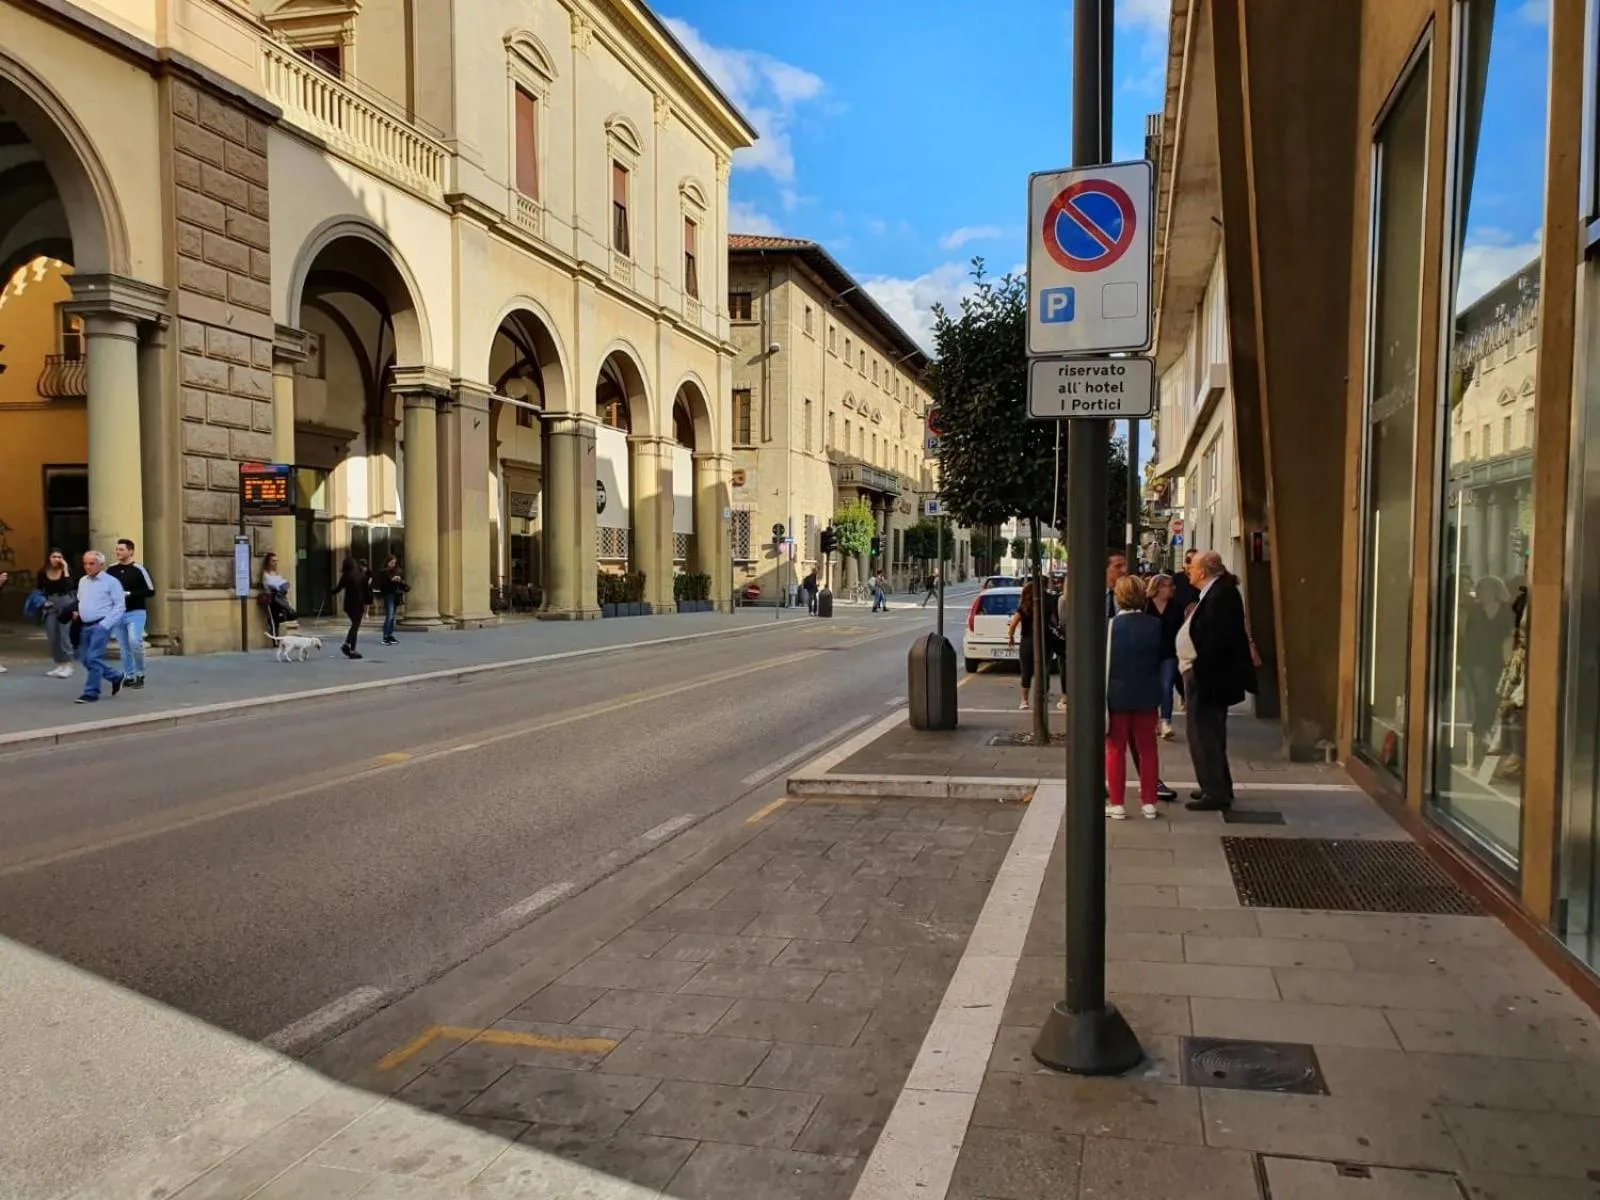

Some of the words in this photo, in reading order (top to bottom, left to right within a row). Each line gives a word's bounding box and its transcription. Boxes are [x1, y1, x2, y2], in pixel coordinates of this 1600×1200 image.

[1047, 293, 1068, 319] P
[1058, 364, 1126, 376] riservato
[1085, 381, 1124, 393] hotel
[1071, 398, 1121, 411] Portici
